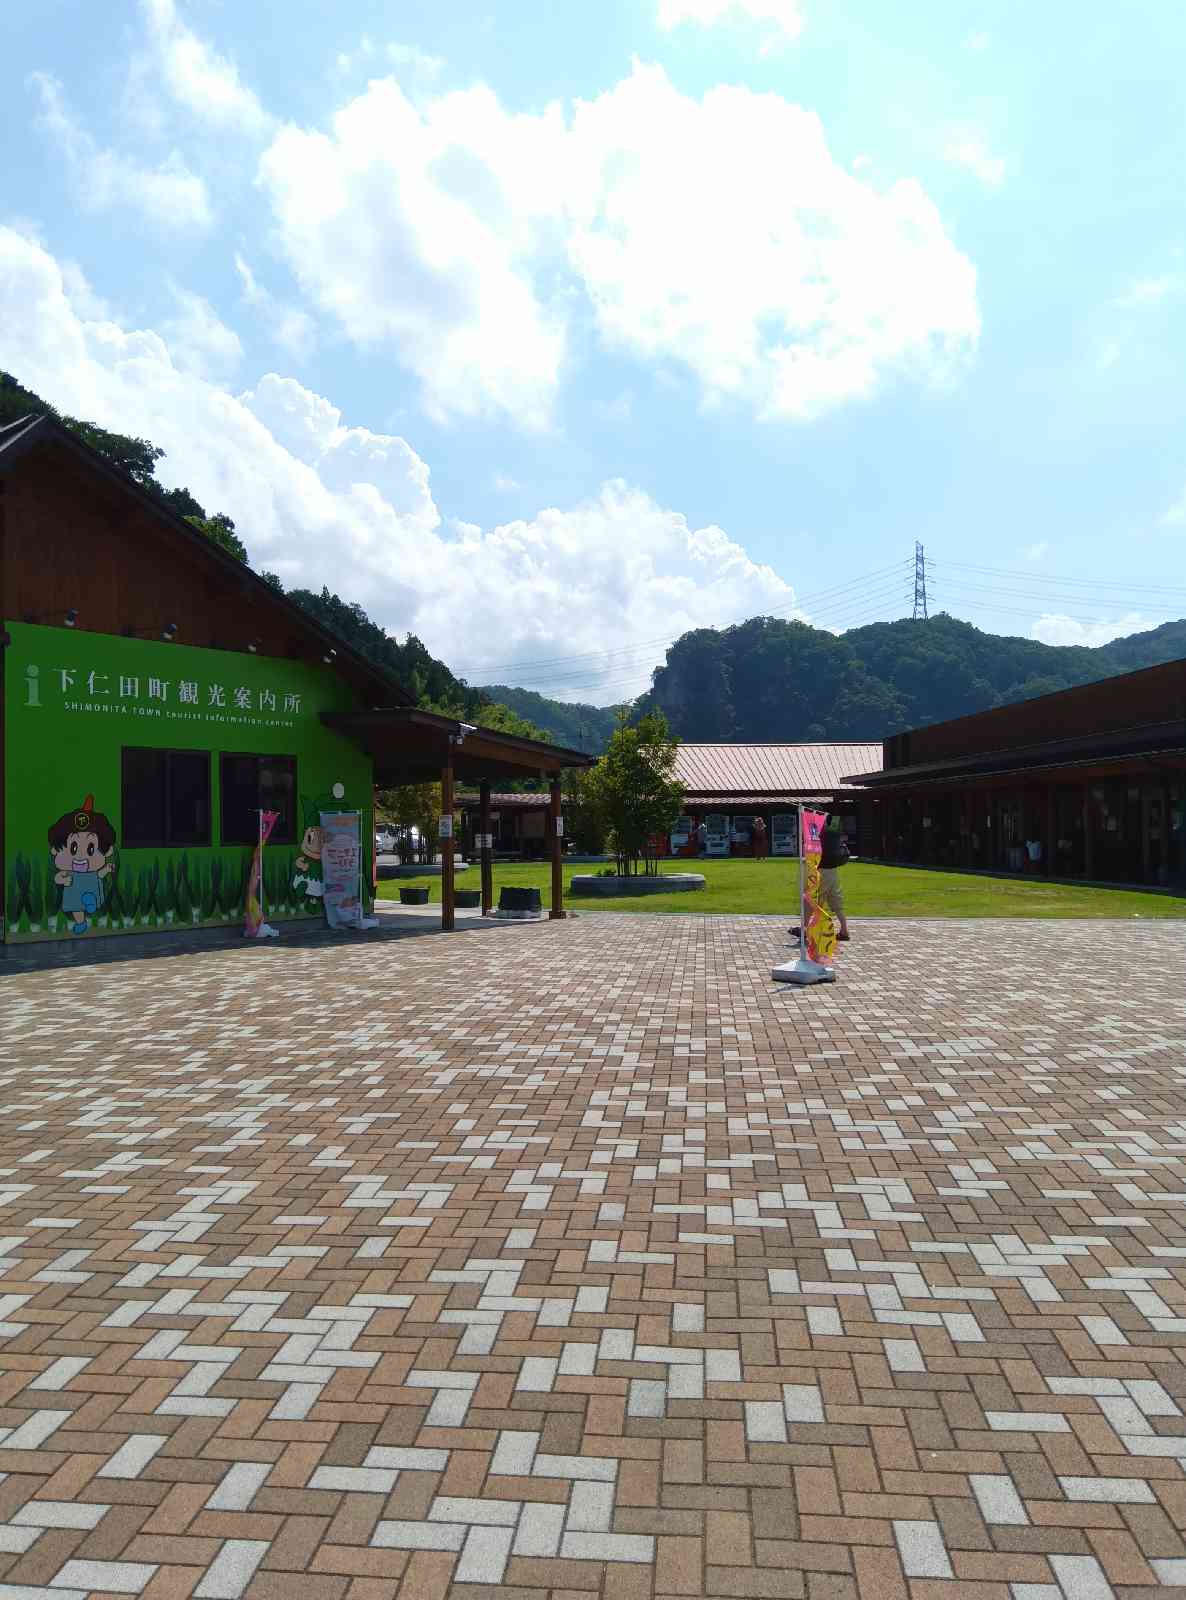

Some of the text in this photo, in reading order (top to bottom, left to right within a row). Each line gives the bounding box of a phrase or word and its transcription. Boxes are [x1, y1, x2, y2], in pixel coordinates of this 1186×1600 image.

[49, 668, 302, 714] 下仁田町観光案内所
[65, 701, 127, 714] SHIMONITA
[133, 706, 161, 717] TOWN
